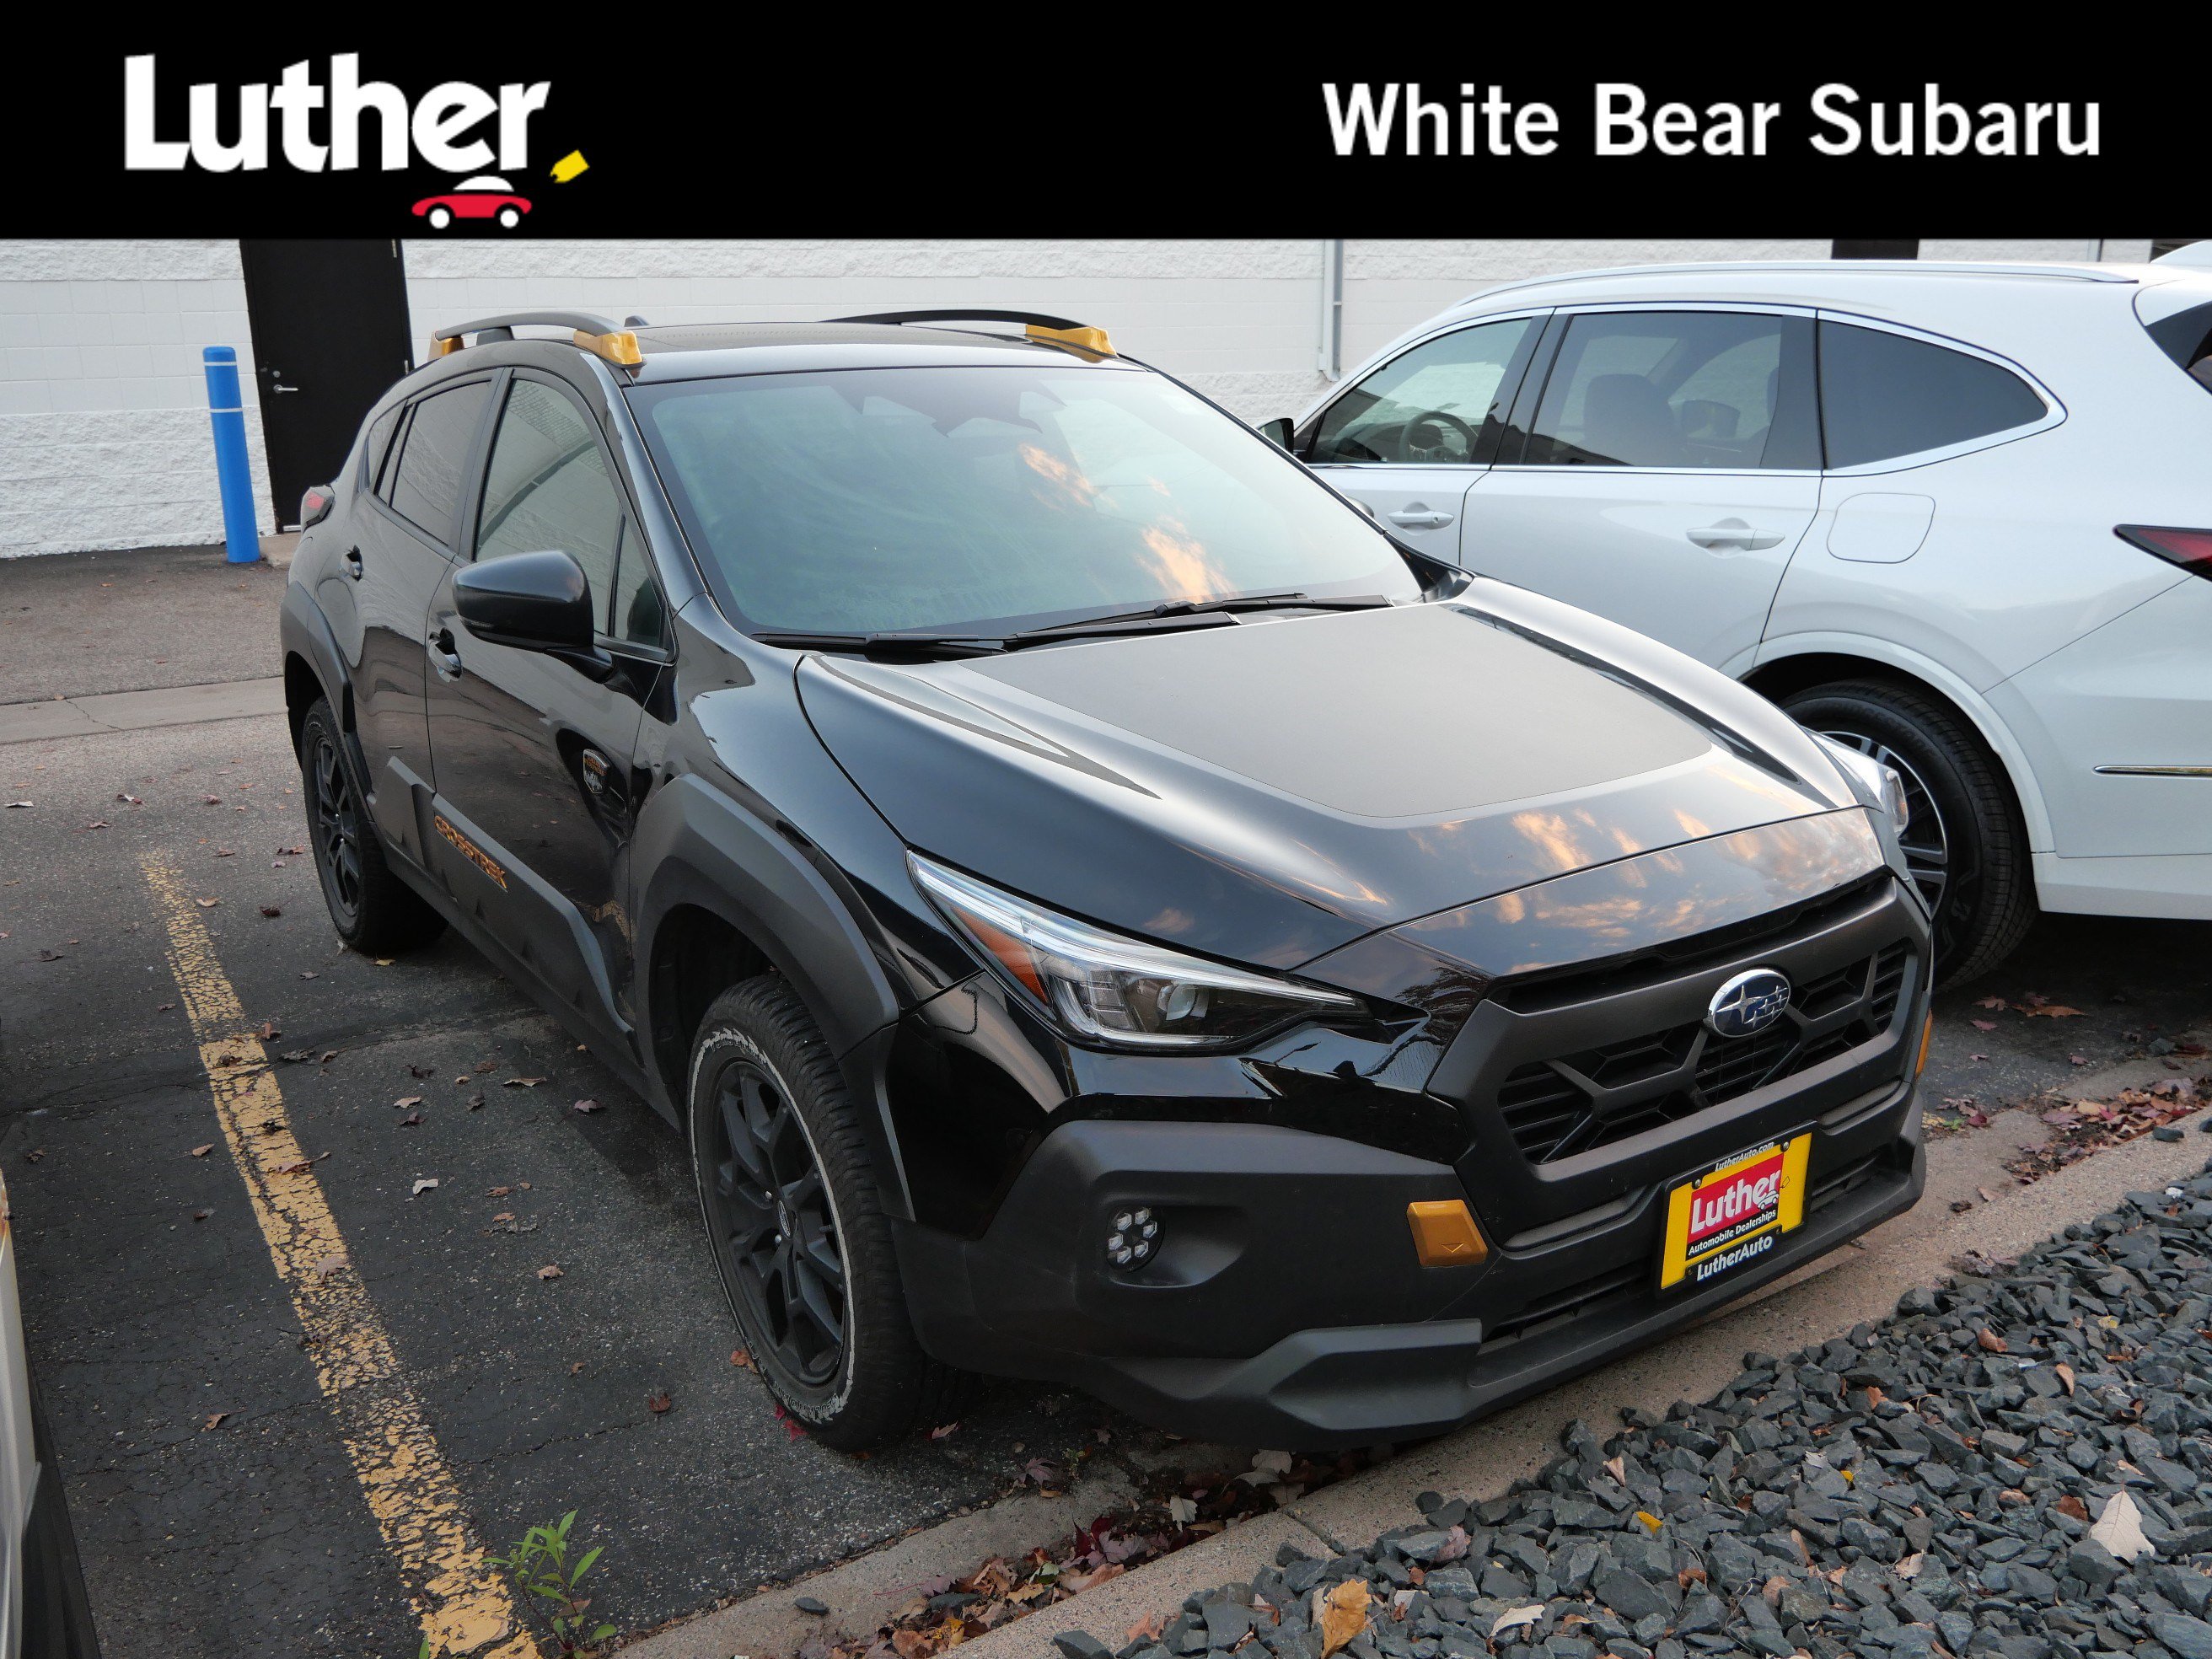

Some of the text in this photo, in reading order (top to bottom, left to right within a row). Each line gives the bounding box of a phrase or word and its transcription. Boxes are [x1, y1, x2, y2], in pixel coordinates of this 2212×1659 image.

[434, 815, 507, 889] CROSSTREK
[1715, 1141, 1774, 1172] LutherAuto.com
[1691, 1169, 1781, 1233] Luther
[1689, 1209, 1776, 1256] Automobile Dealerships
[1696, 1235, 1773, 1281] LutherAuto
